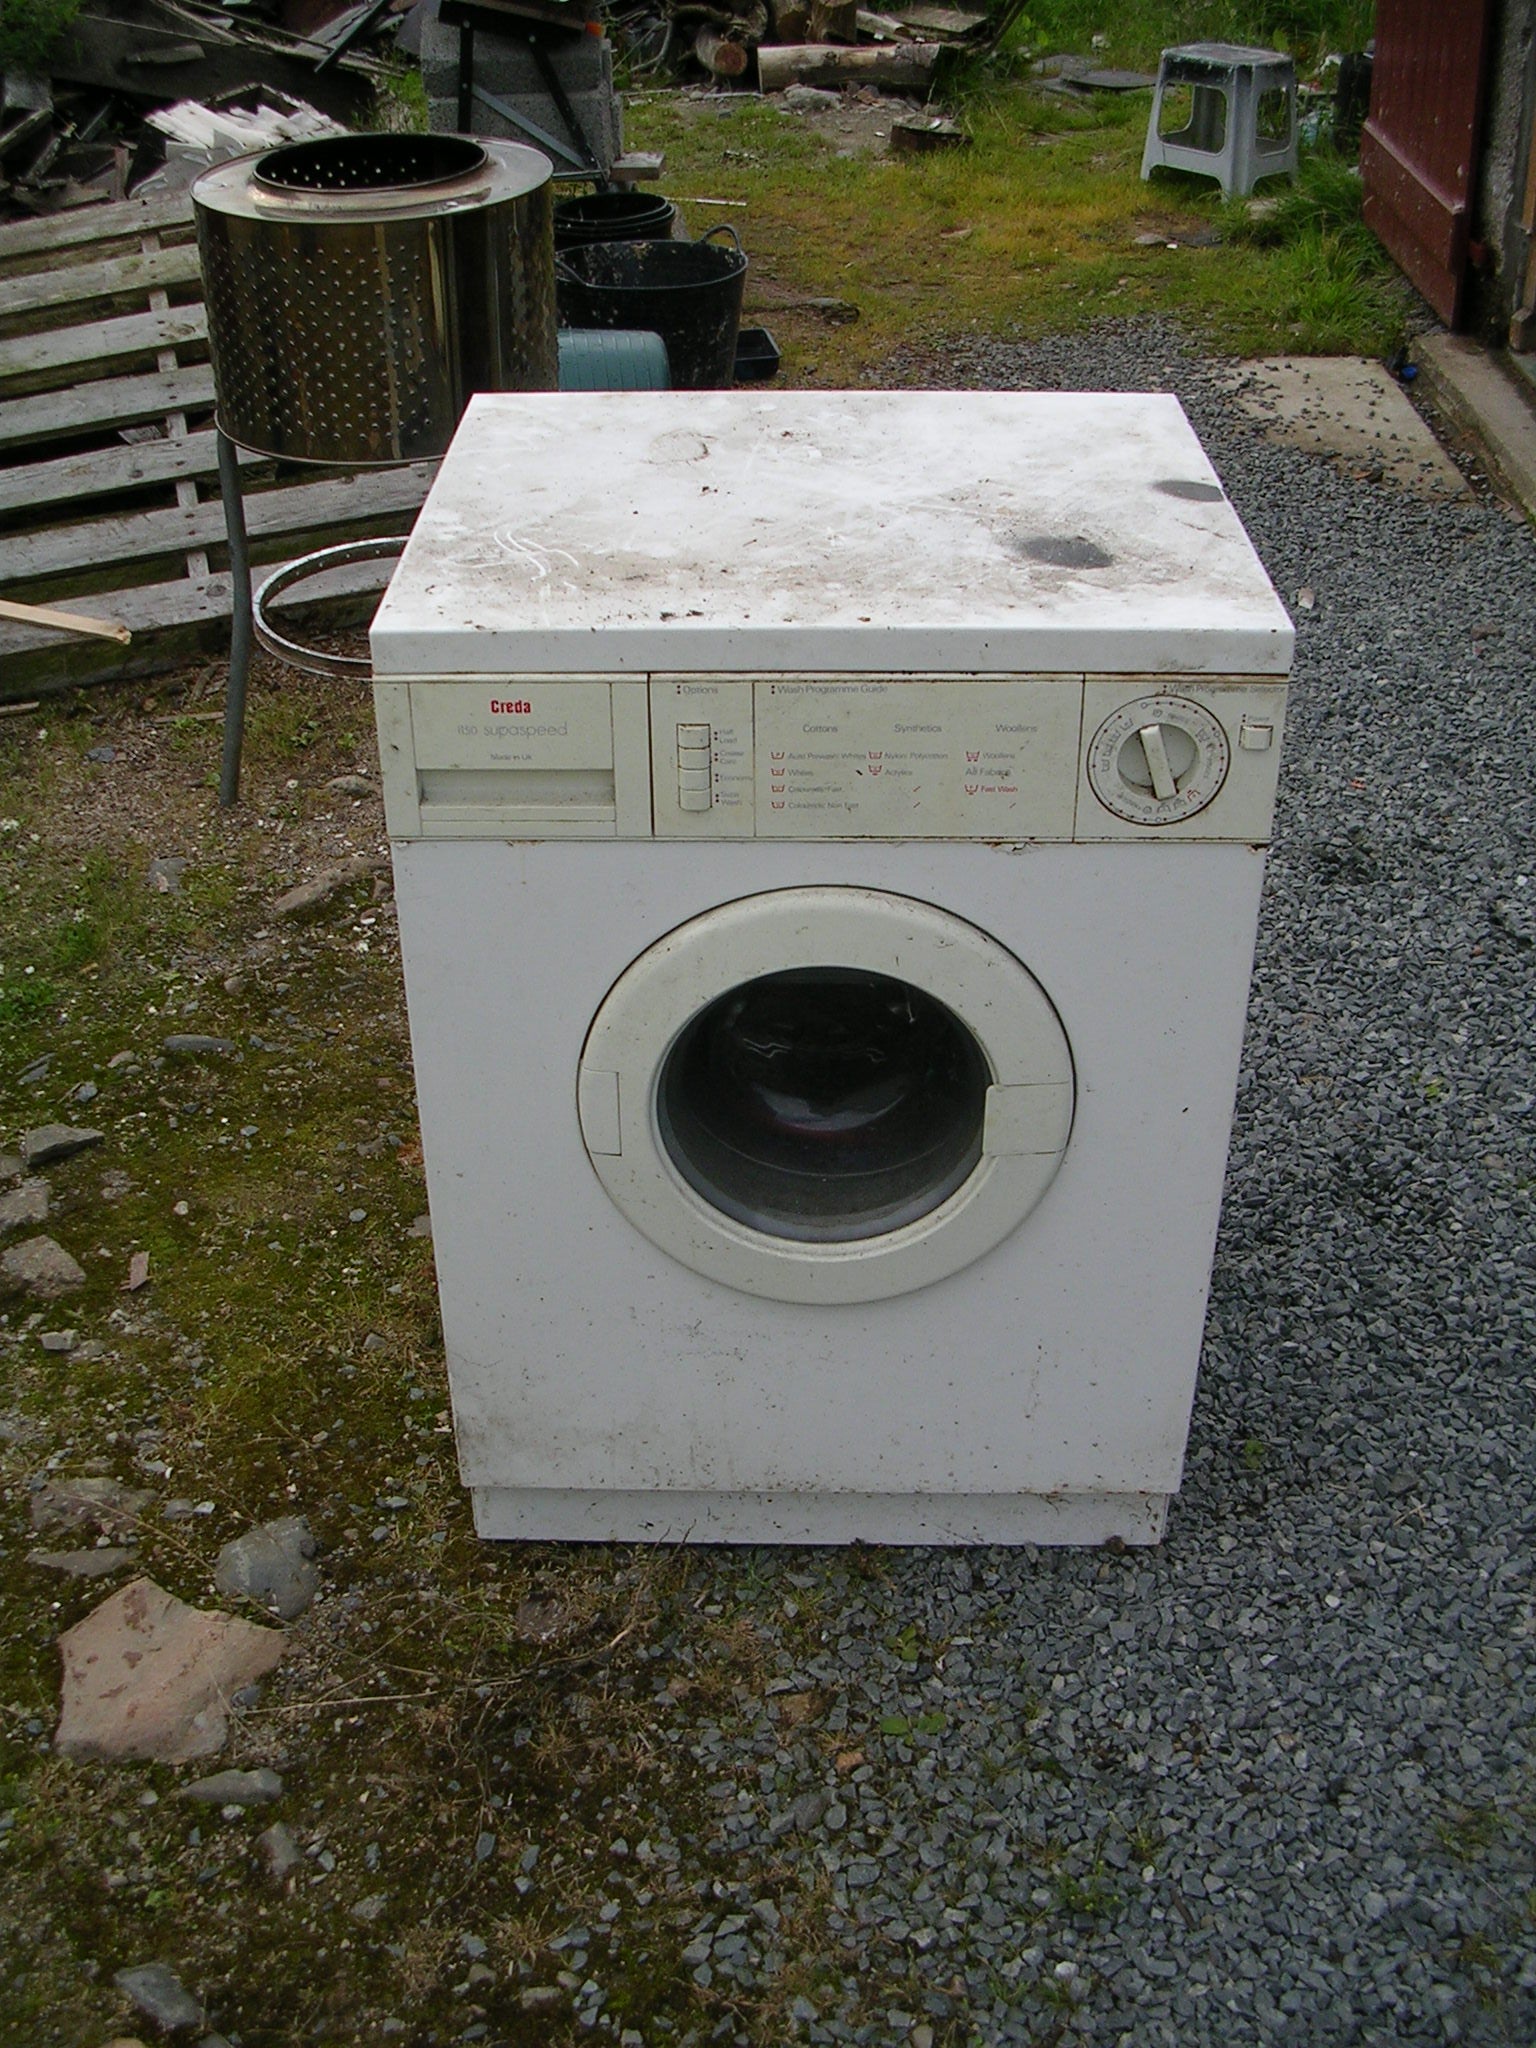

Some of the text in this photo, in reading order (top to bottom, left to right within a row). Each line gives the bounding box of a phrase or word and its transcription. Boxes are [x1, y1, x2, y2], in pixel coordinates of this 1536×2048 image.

[683, 685, 719, 696] Options
[806, 685, 859, 695] Programme
[491, 699, 531, 714] Creda
[483, 721, 568, 739] supaspeed
[803, 724, 839, 733] Cottons
[894, 724, 943, 734] Synthetics
